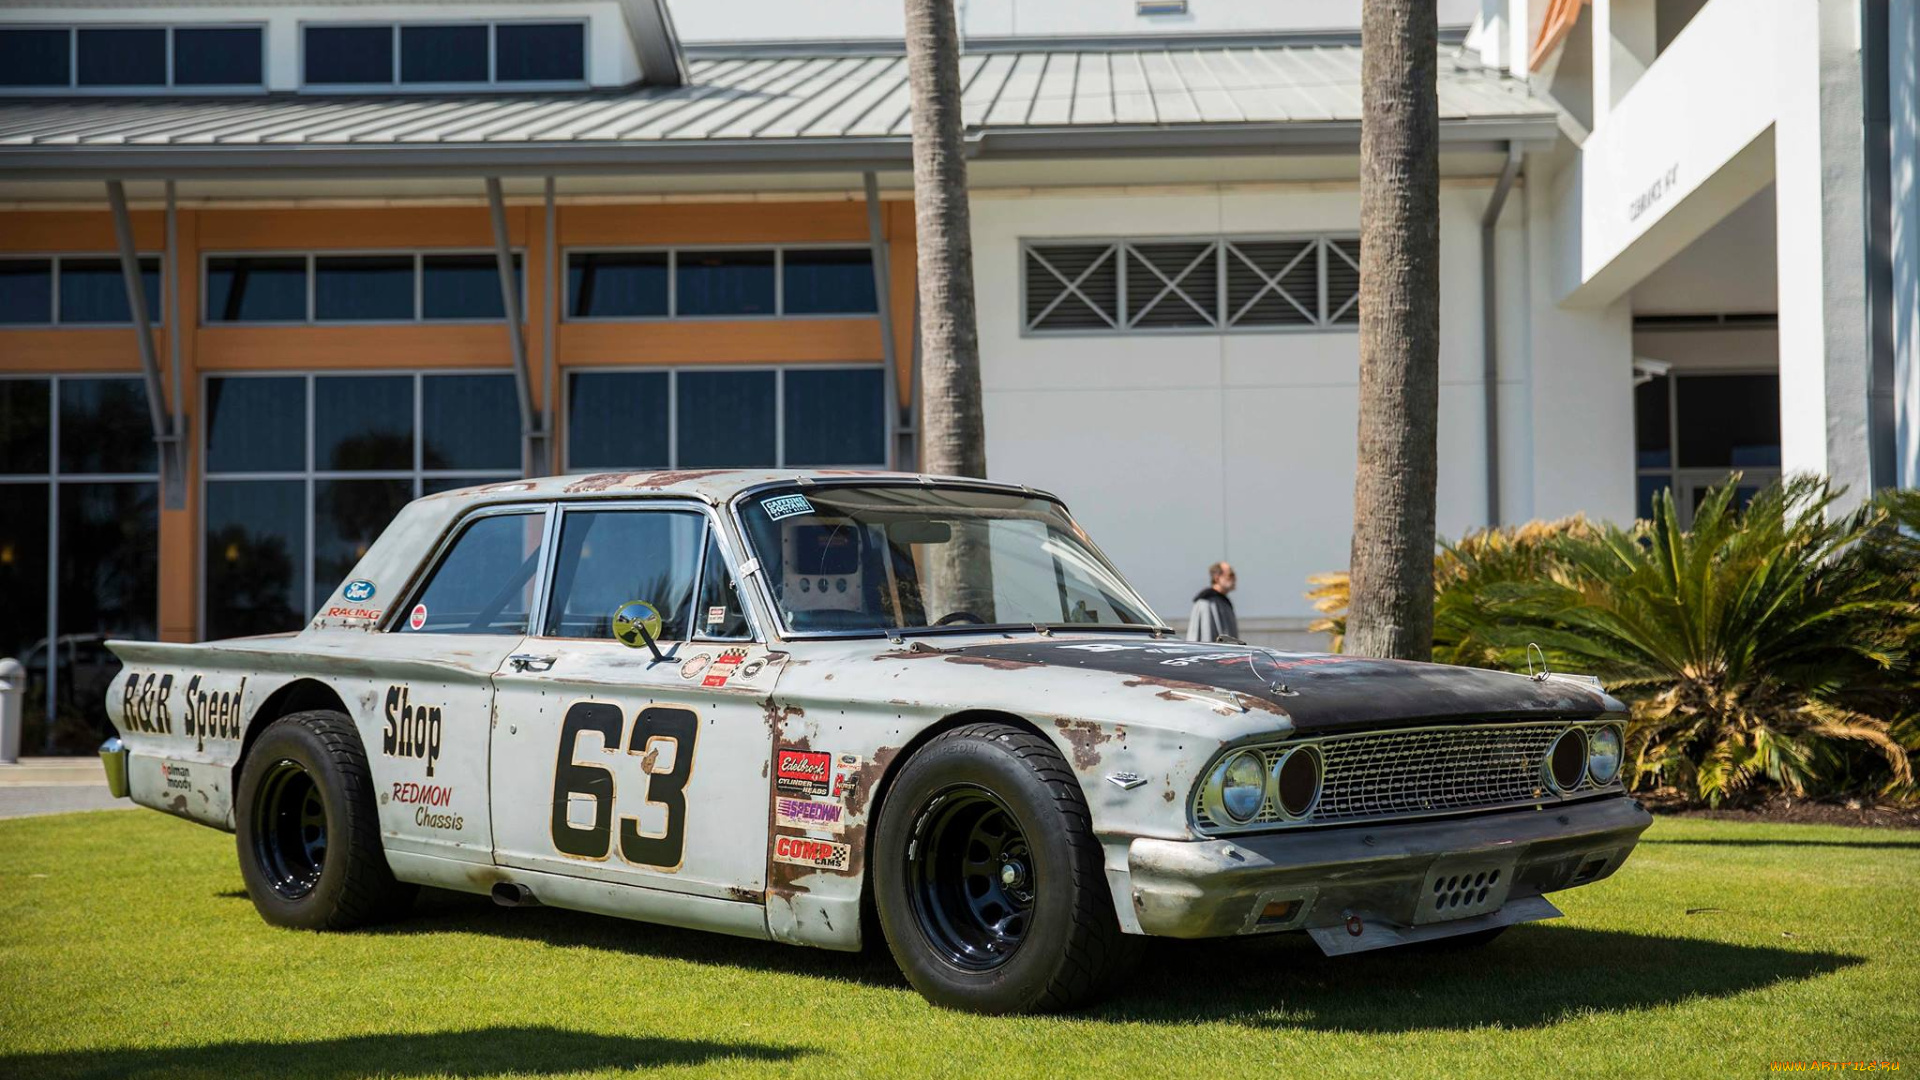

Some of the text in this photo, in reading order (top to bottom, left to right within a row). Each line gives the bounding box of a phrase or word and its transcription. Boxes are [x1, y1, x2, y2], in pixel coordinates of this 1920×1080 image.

[346, 582, 371, 599] Ford
[328, 607, 382, 620] RACING
[123, 673, 247, 752] R&R Speed
[383, 684, 442, 778] Shop
[782, 757, 825, 775] Edelbrock
[551, 699, 700, 871] 63
[778, 778, 813, 788] CYLINDER
[802, 786, 827, 796] HEADS
[392, 782, 452, 807] REDMON
[415, 806, 464, 831] Chassis
[789, 800, 842, 822] SPEEDWAY
[777, 838, 833, 860] COMP
[814, 858, 842, 867] CAMS
